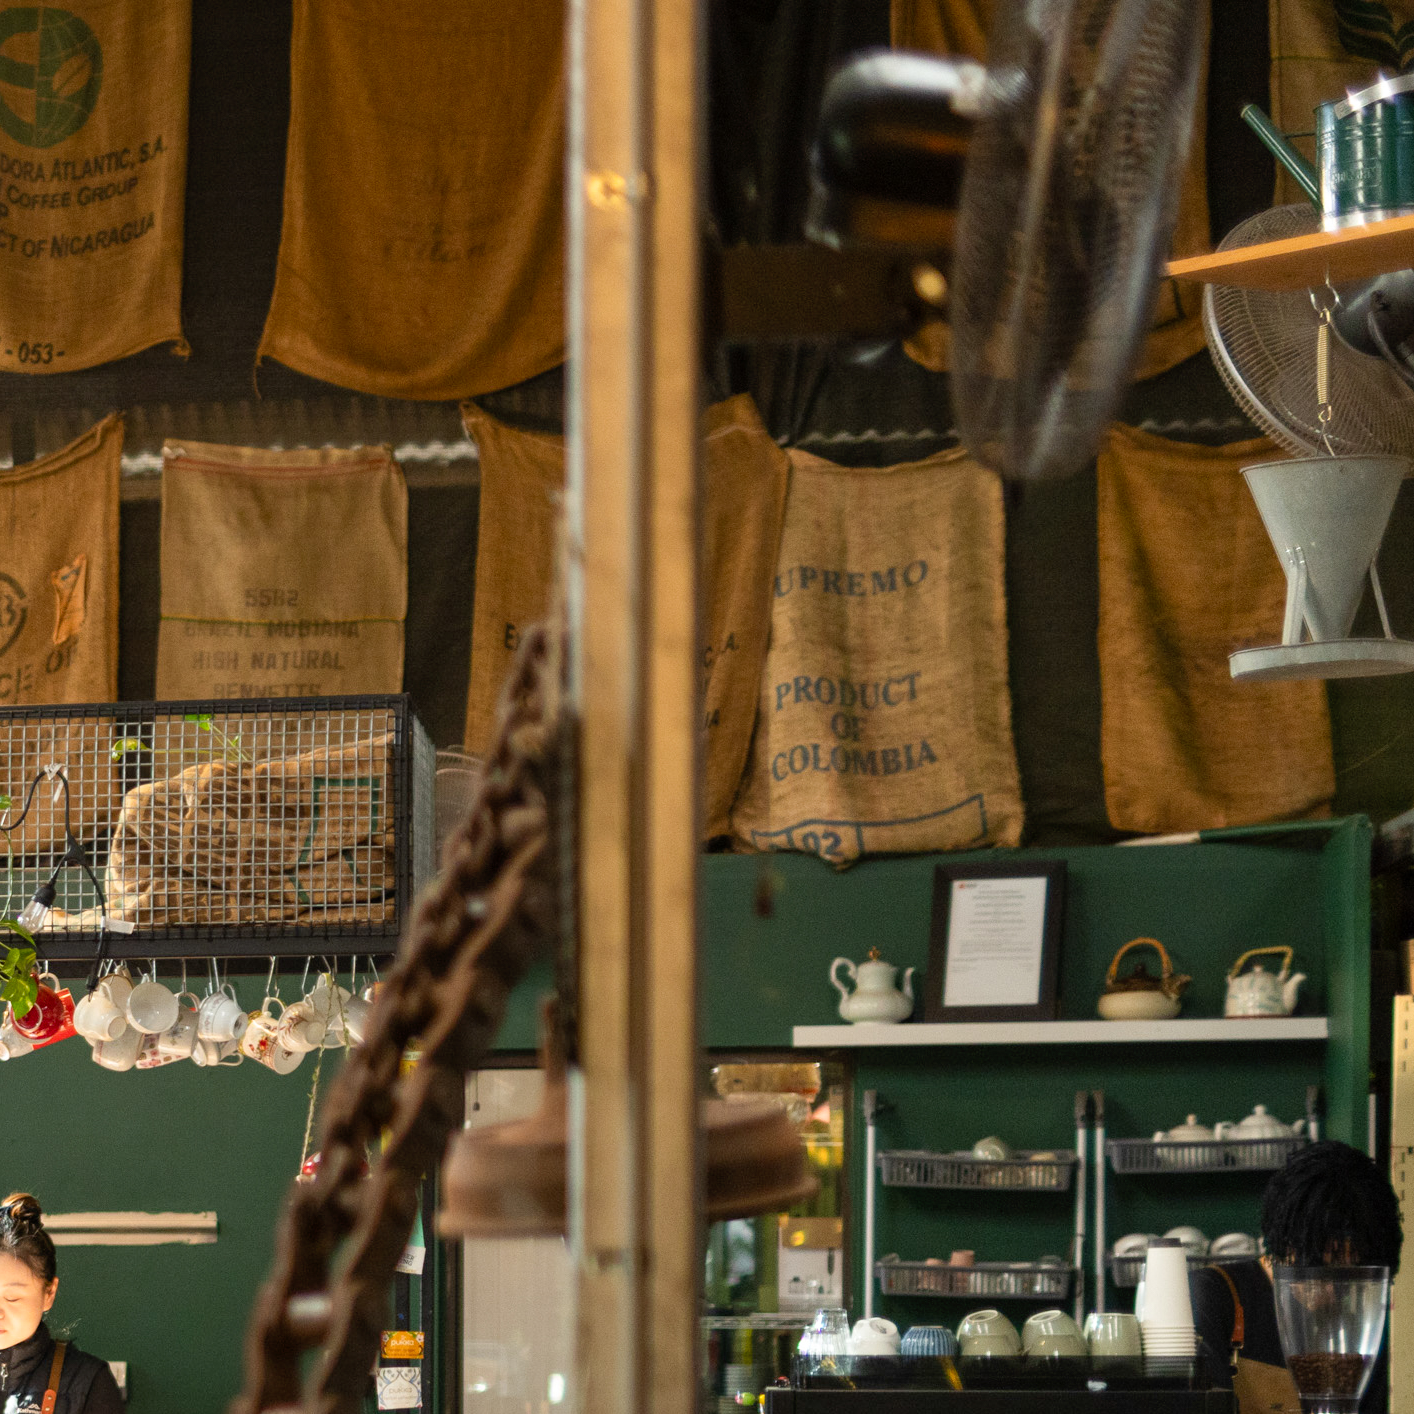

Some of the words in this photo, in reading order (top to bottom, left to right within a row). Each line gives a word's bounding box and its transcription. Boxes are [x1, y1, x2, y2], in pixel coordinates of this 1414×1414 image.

[6, 183, 72, 210] COFFEE
[76, 176, 140, 208] GROUP
[23, 237, 46, 259] OF
[49, 211, 156, 259] NICARAGUA
[775, 559, 930, 598] UPREMO
[250, 650, 346, 672] NATURAL
[775, 671, 922, 712] PRODUCT
[830, 711, 864, 742] OF
[772, 739, 938, 783] COLOMBIA
[390, 1338, 415, 1347] pukka
